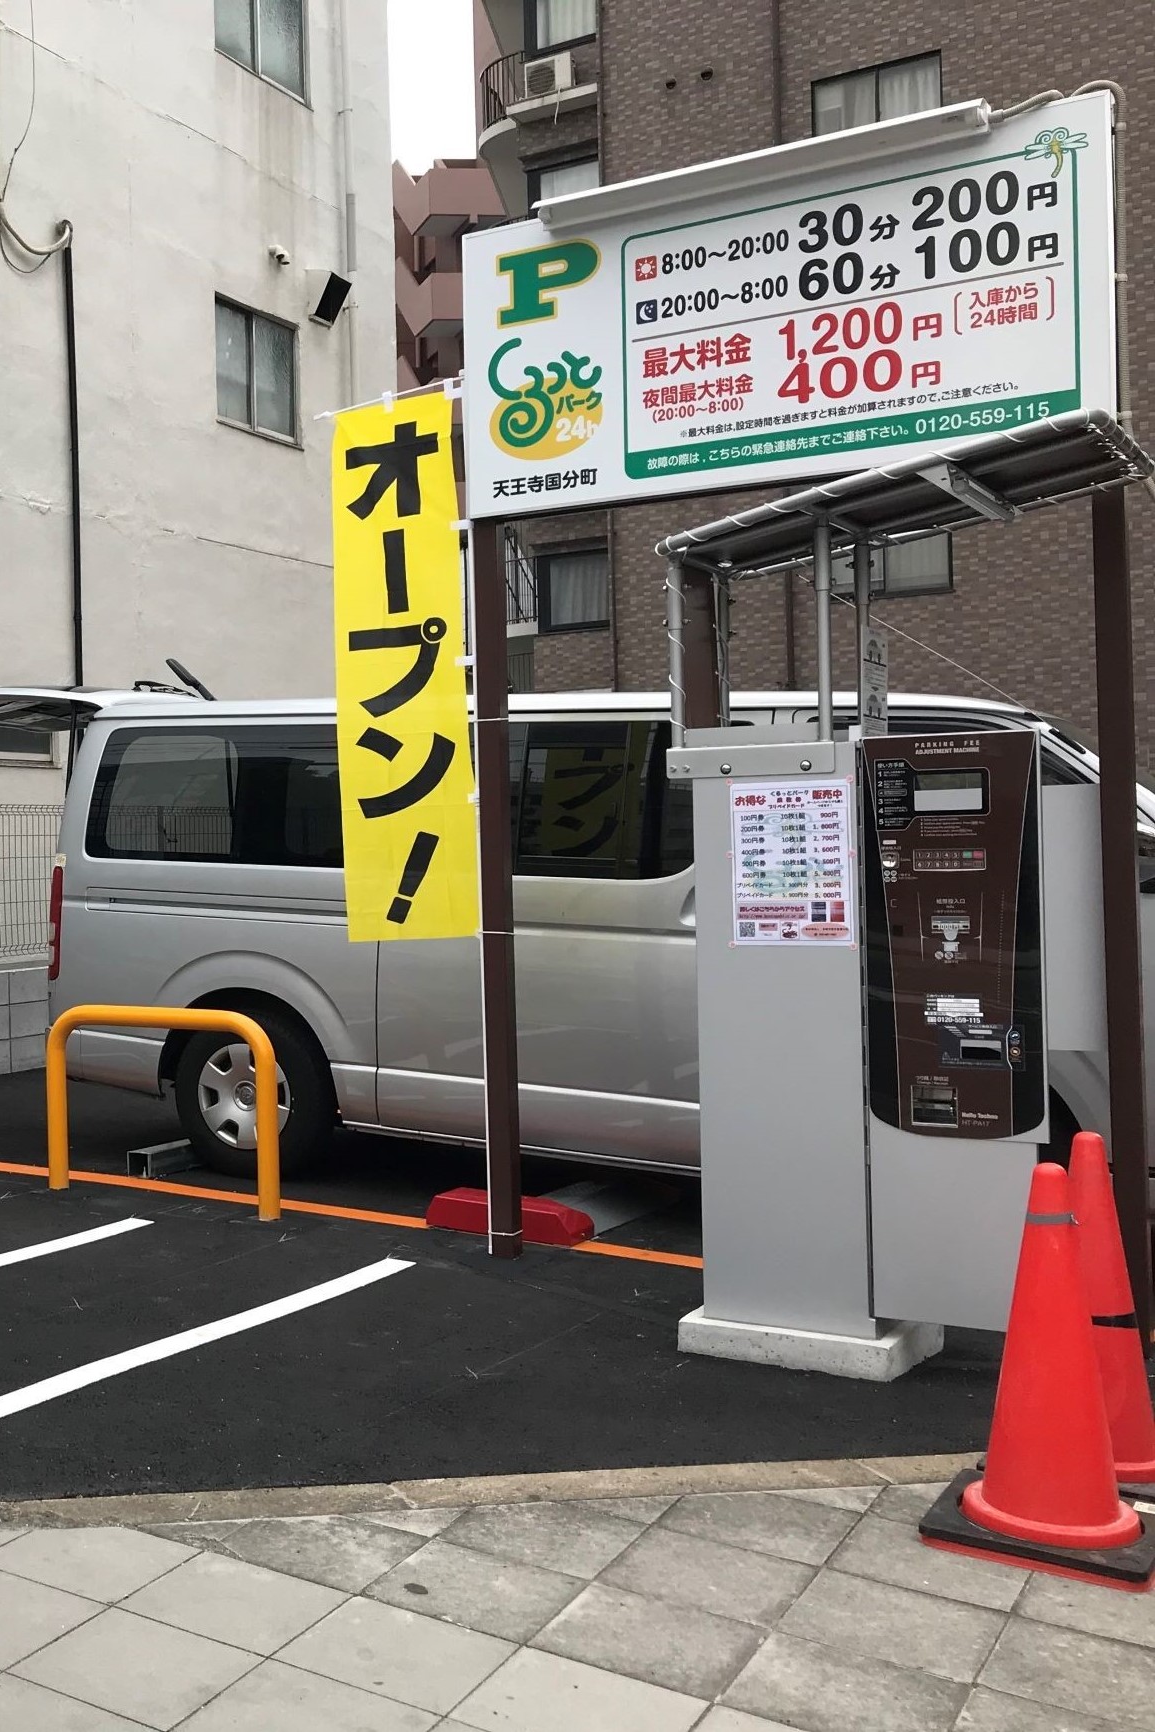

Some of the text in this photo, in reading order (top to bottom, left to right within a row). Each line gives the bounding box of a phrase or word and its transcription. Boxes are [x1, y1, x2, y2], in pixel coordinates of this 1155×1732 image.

[496, 238, 602, 329] P
[969, 282, 1038, 309] 入庫から
[970, 303, 1038, 329] 24時間
[643, 333, 751, 378] 最大料金
[556, 391, 602, 415] パーク
[643, 374, 753, 409] 夜間最大料金
[916, 401, 1049, 434] 0120-559-115
[493, 468, 597, 498] 天王寺国分町
[735, 795, 766, 806] お得な
[812, 789, 842, 800] 販売中
